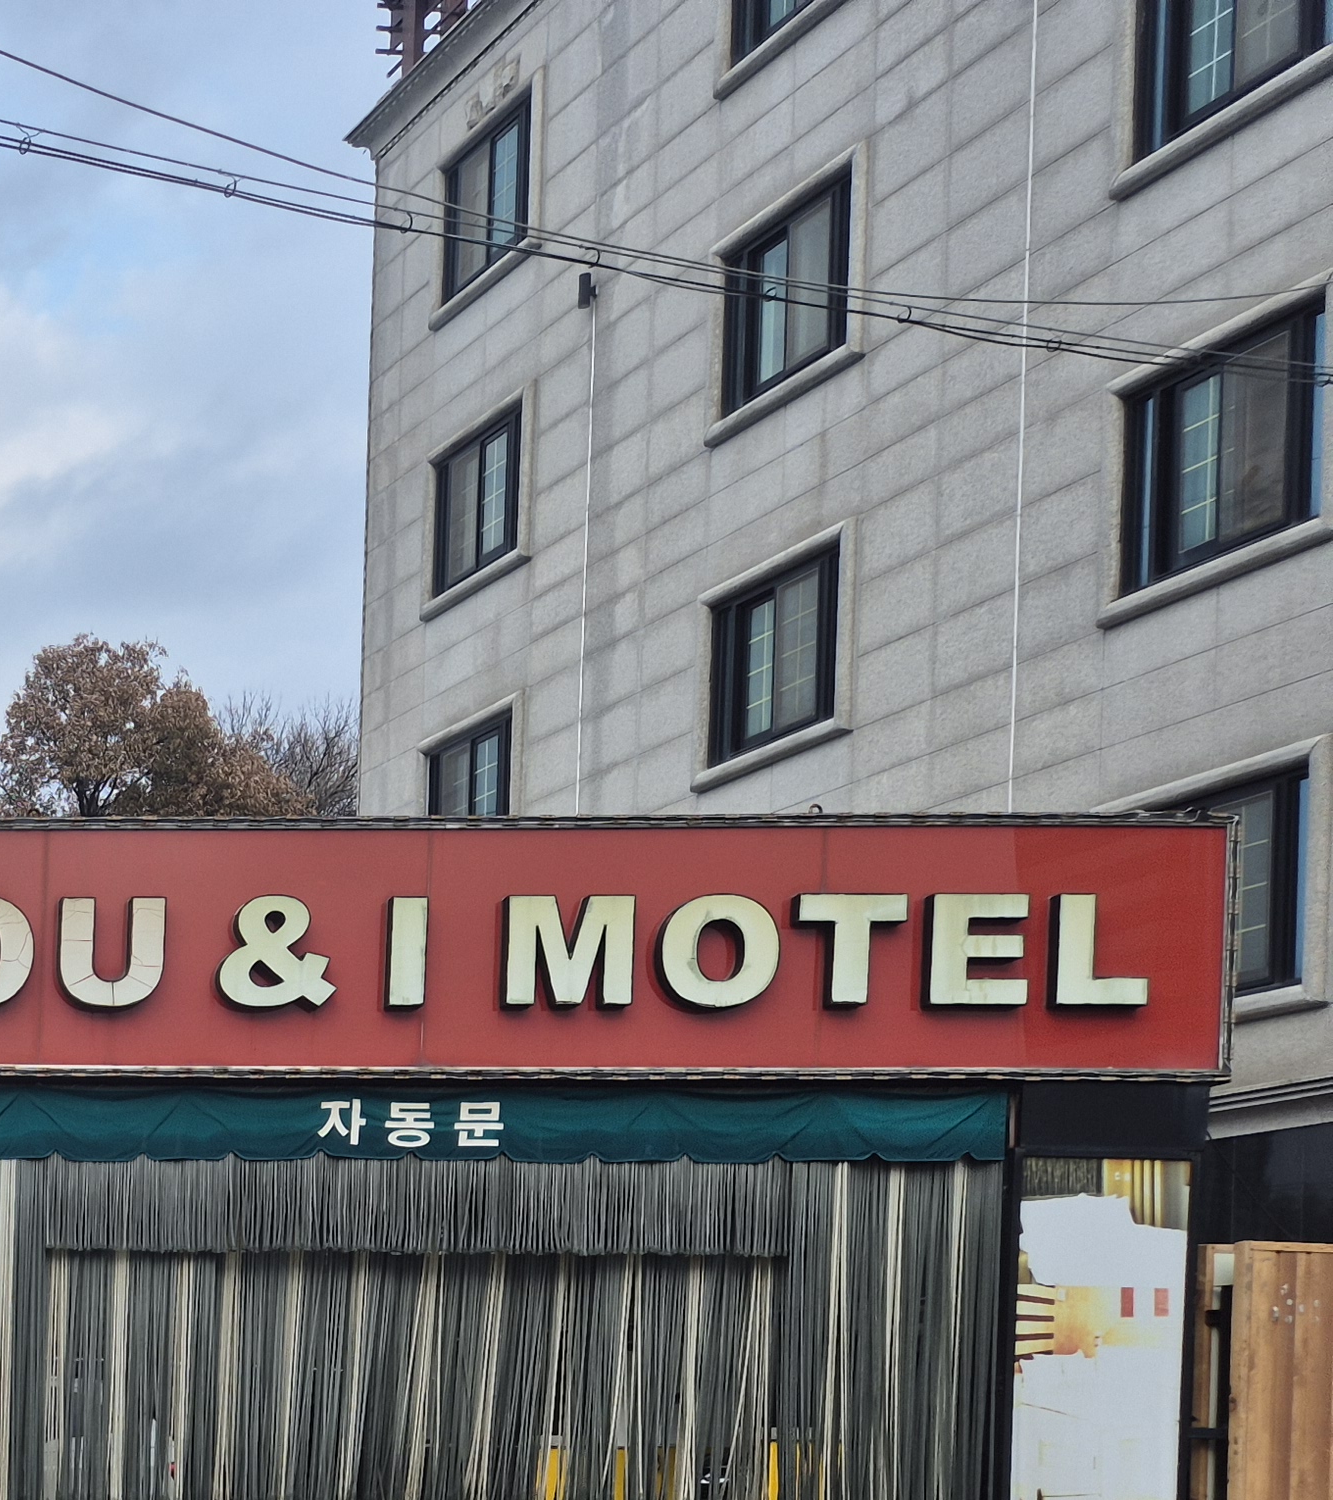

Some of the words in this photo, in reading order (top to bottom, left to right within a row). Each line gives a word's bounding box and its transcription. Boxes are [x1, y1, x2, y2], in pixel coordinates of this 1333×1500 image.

[217, 893, 337, 1012] &
[384, 895, 429, 1010] I
[501, 893, 1149, 1010] MOTEL
[317, 1098, 504, 1147] 자동문
